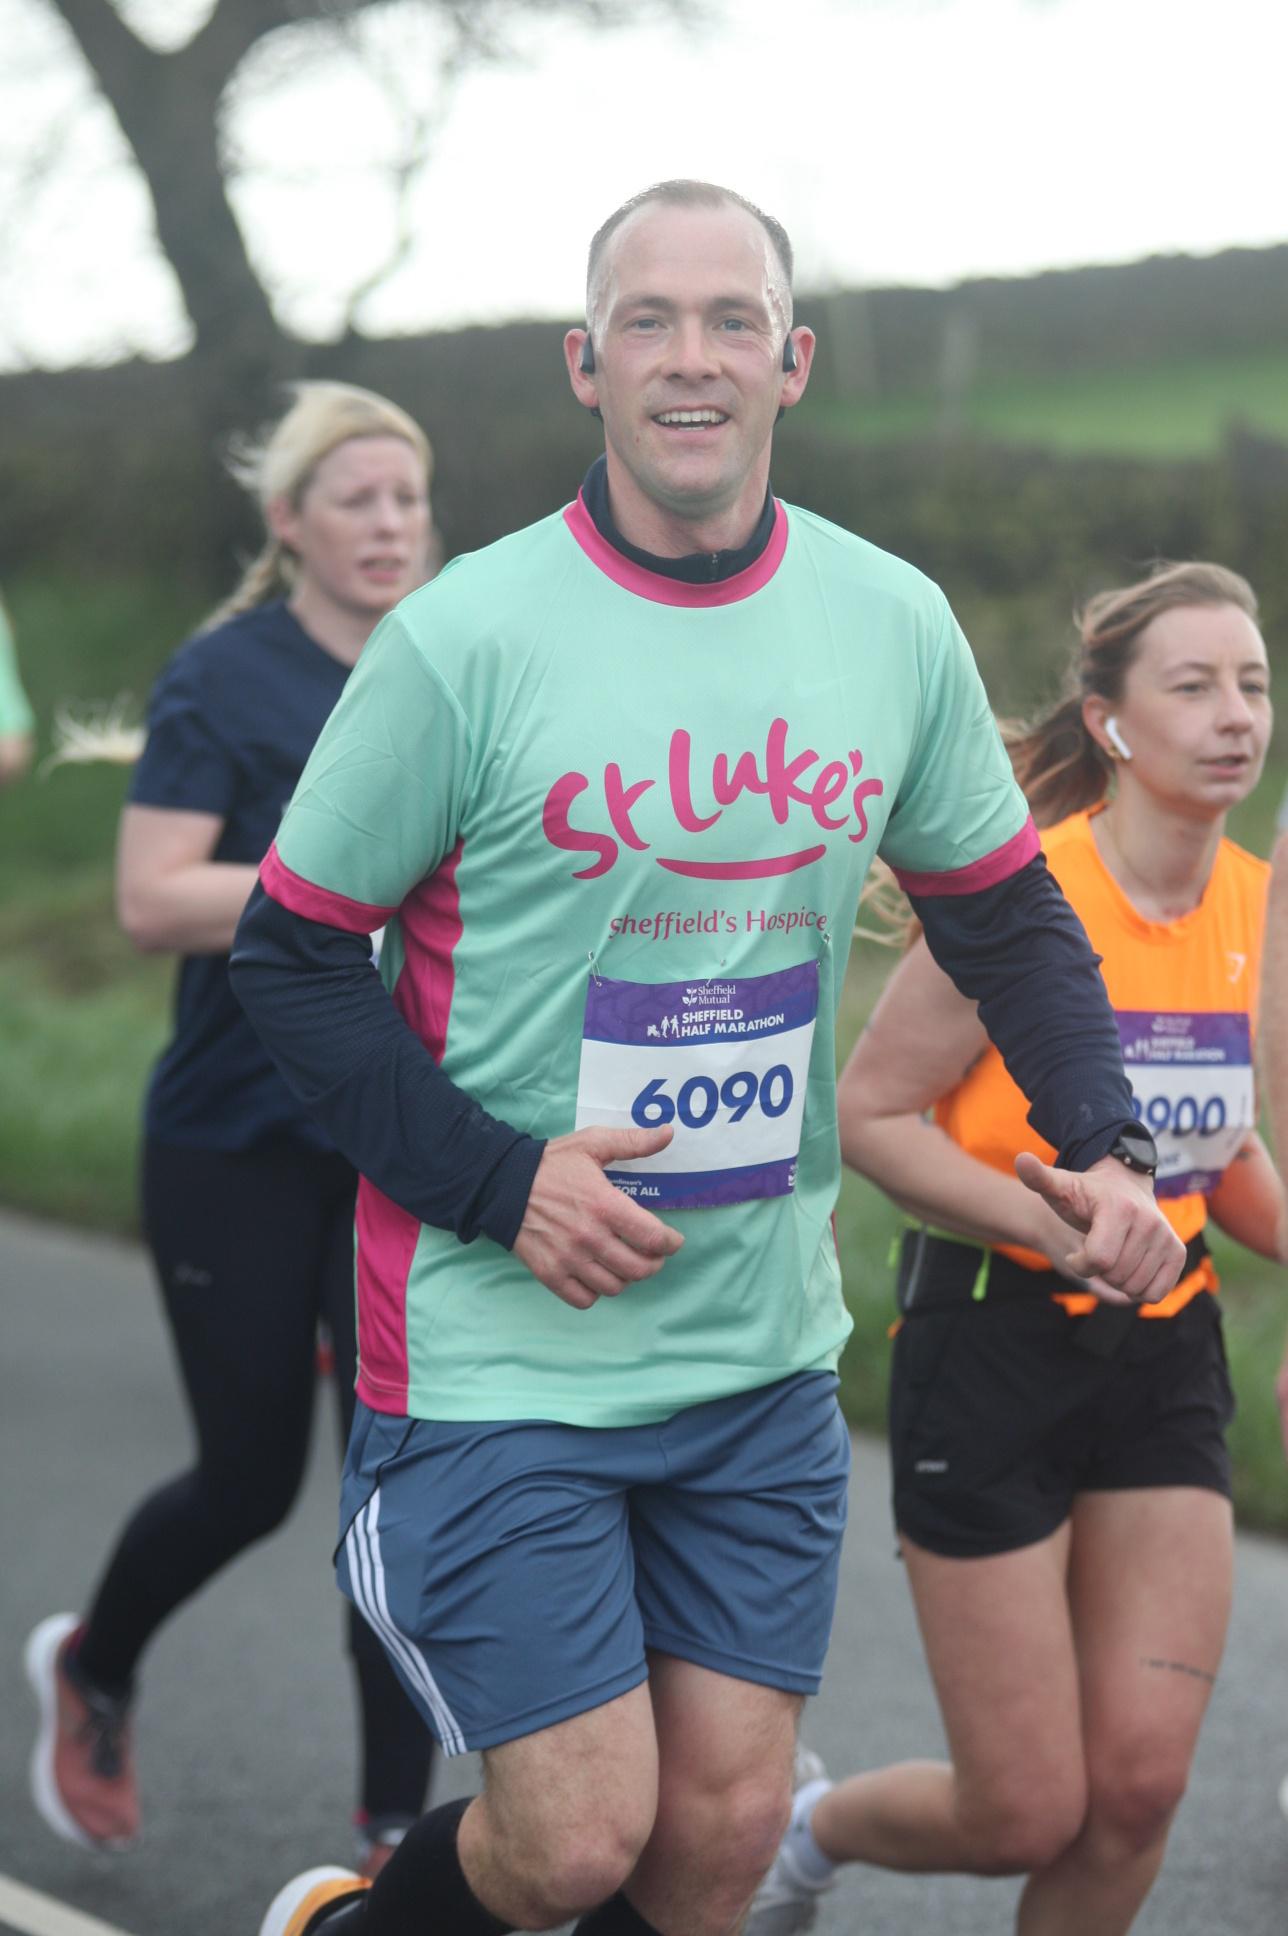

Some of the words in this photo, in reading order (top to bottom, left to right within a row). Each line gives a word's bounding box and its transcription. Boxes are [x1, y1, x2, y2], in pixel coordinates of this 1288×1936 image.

[543, 762, 656, 879] St
[669, 718, 883, 843] Luke's
[746, 906, 828, 934] Hospice
[698, 985, 736, 996] Sheffield
[698, 995, 730, 1006] Mutual
[681, 1024, 711, 1037] HALF
[714, 1013, 784, 1034] MARATHON
[682, 1009, 743, 1023] SHEFFIELD
[631, 1064, 794, 1129] 6090
[640, 1186, 660, 1196] ALL
